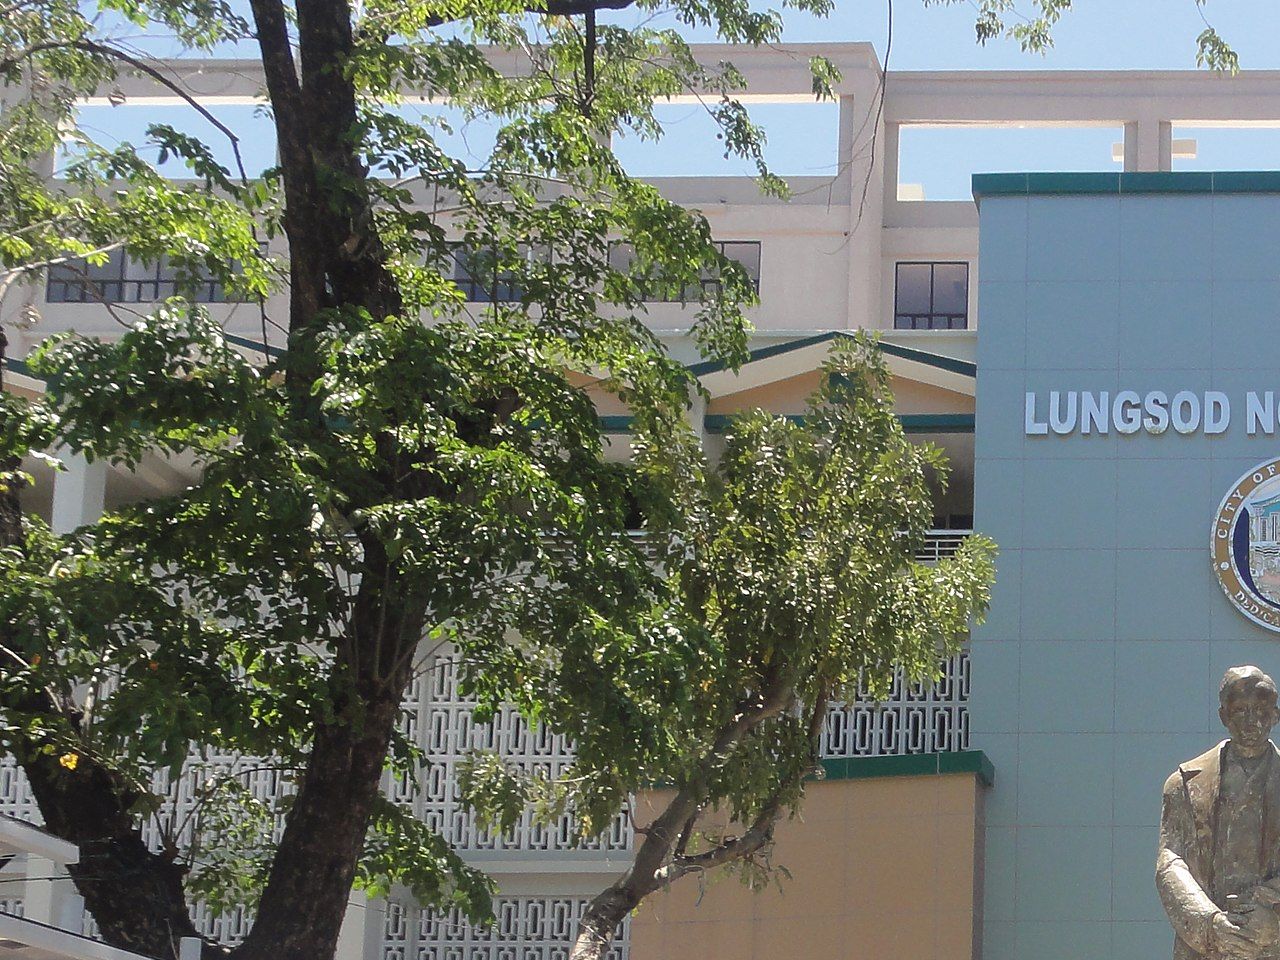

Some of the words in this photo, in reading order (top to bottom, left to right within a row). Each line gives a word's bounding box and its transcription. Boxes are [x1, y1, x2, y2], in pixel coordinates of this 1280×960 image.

[1025, 390, 1231, 435] LUNGSOD
[1217, 489, 1245, 539] CITY
[1252, 464, 1277, 484] OF
